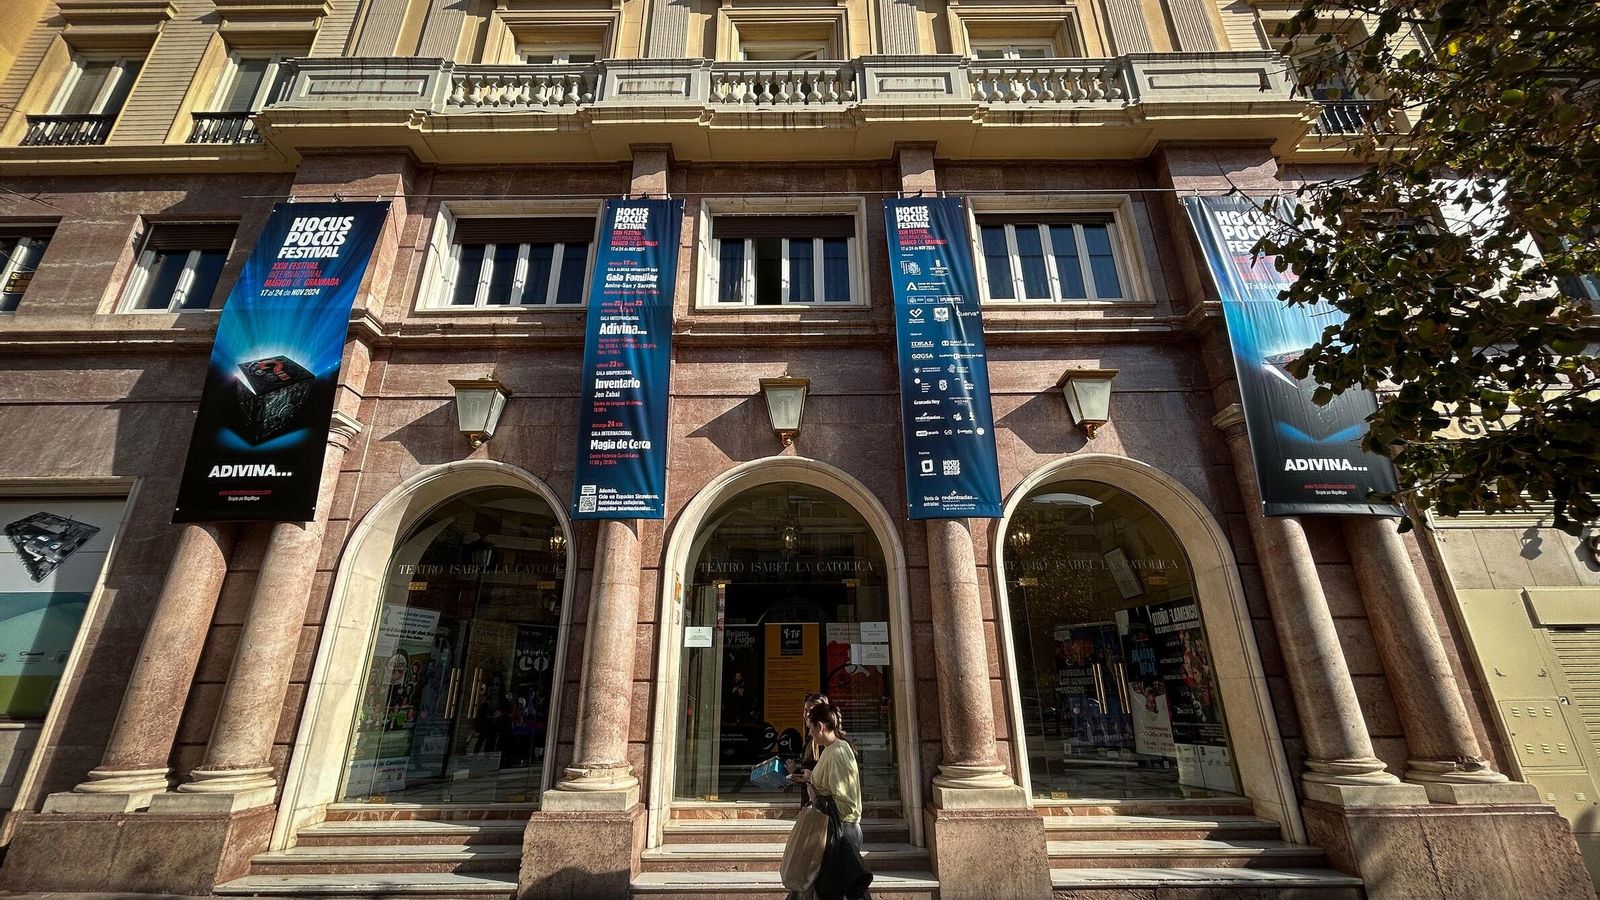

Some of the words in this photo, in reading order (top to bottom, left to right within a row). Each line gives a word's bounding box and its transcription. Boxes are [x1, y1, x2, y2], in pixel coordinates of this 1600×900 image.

[616, 208, 649, 216] HOCUS
[896, 206, 928, 214] HOCUS
[290, 216, 354, 231] HOCUS
[897, 214, 929, 222] POCUS
[284, 231, 348, 246] POCUS
[277, 246, 339, 258] FESTIVAL
[626, 273, 658, 281] Familiar
[599, 323, 647, 334] Adivina...
[595, 378, 640, 389] Inventario
[590, 440, 616, 450] Magia
[617, 439, 628, 449] de
[629, 439, 651, 449] Cerca
[1285, 458, 1368, 471] ADIVINA...
[208, 464, 292, 478] ADIVINA...
[399, 564, 444, 575] TEATRO
[450, 564, 490, 575] ISABEL
[495, 564, 509, 574] LA
[516, 563, 565, 574] CATOLIC
[700, 562, 744, 573] TEATRO
[751, 562, 792, 572] ISABEL
[796, 562, 810, 572] LA
[816, 561, 874, 572] CATOLICA
[1003, 560, 1048, 571] TEATRO
[1056, 559, 1098, 570] ISABEL
[1152, 608, 1170, 626] OTOÑO
